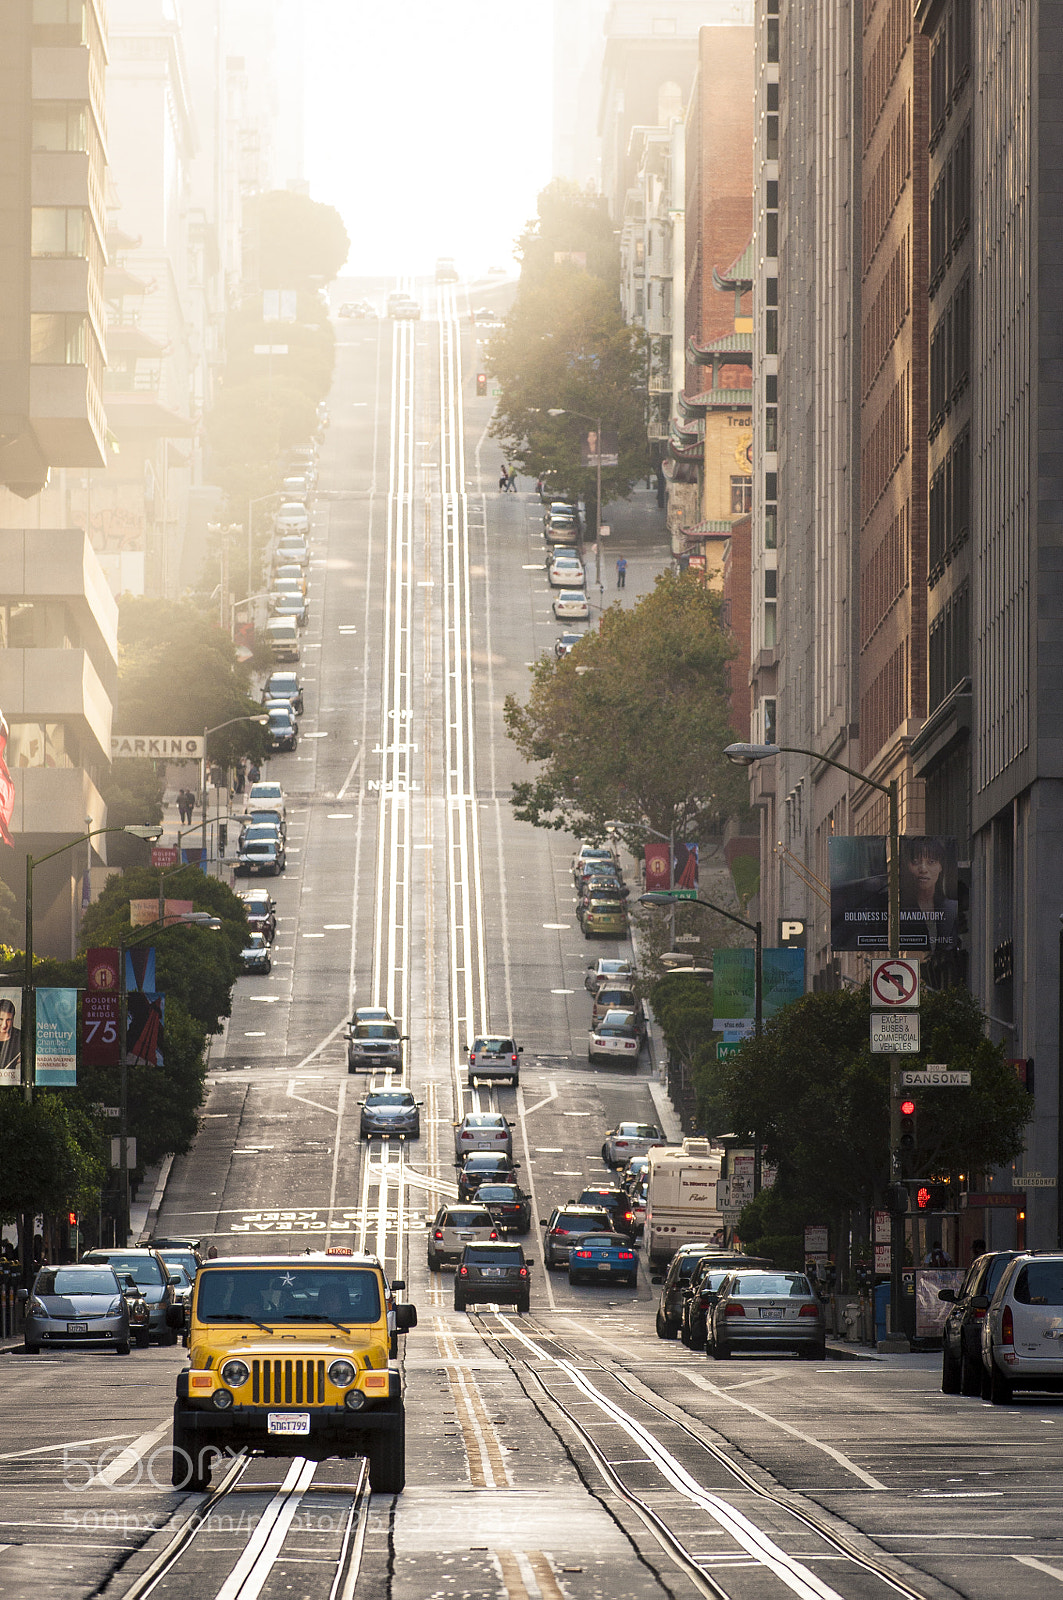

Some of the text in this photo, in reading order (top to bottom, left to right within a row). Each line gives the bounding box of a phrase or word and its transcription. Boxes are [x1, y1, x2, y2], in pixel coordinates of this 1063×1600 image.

[727, 415, 753, 427] Trad
[110, 738, 198, 753] PARKING
[844, 911, 946, 921] BOLDNESS IS MANDATORY.
[781, 921, 804, 940] P
[929, 936, 953, 944] SHINE
[881, 1015, 908, 1024] EXCEPT
[36, 1022, 58, 1030] New
[881, 1024, 904, 1033] BUSES
[36, 1030, 74, 1041] Century
[85, 1020, 117, 1043] 75
[36, 1038, 68, 1047] Chamber
[873, 1033, 918, 1042] COMMERCIAL
[36, 1046, 71, 1054] Orchestra
[879, 1042, 912, 1051] VEHICLES
[905, 1073, 968, 1084] SANSOME
[242, 1211, 318, 1222] KEEP
[230, 1221, 327, 1232] CLEAR
